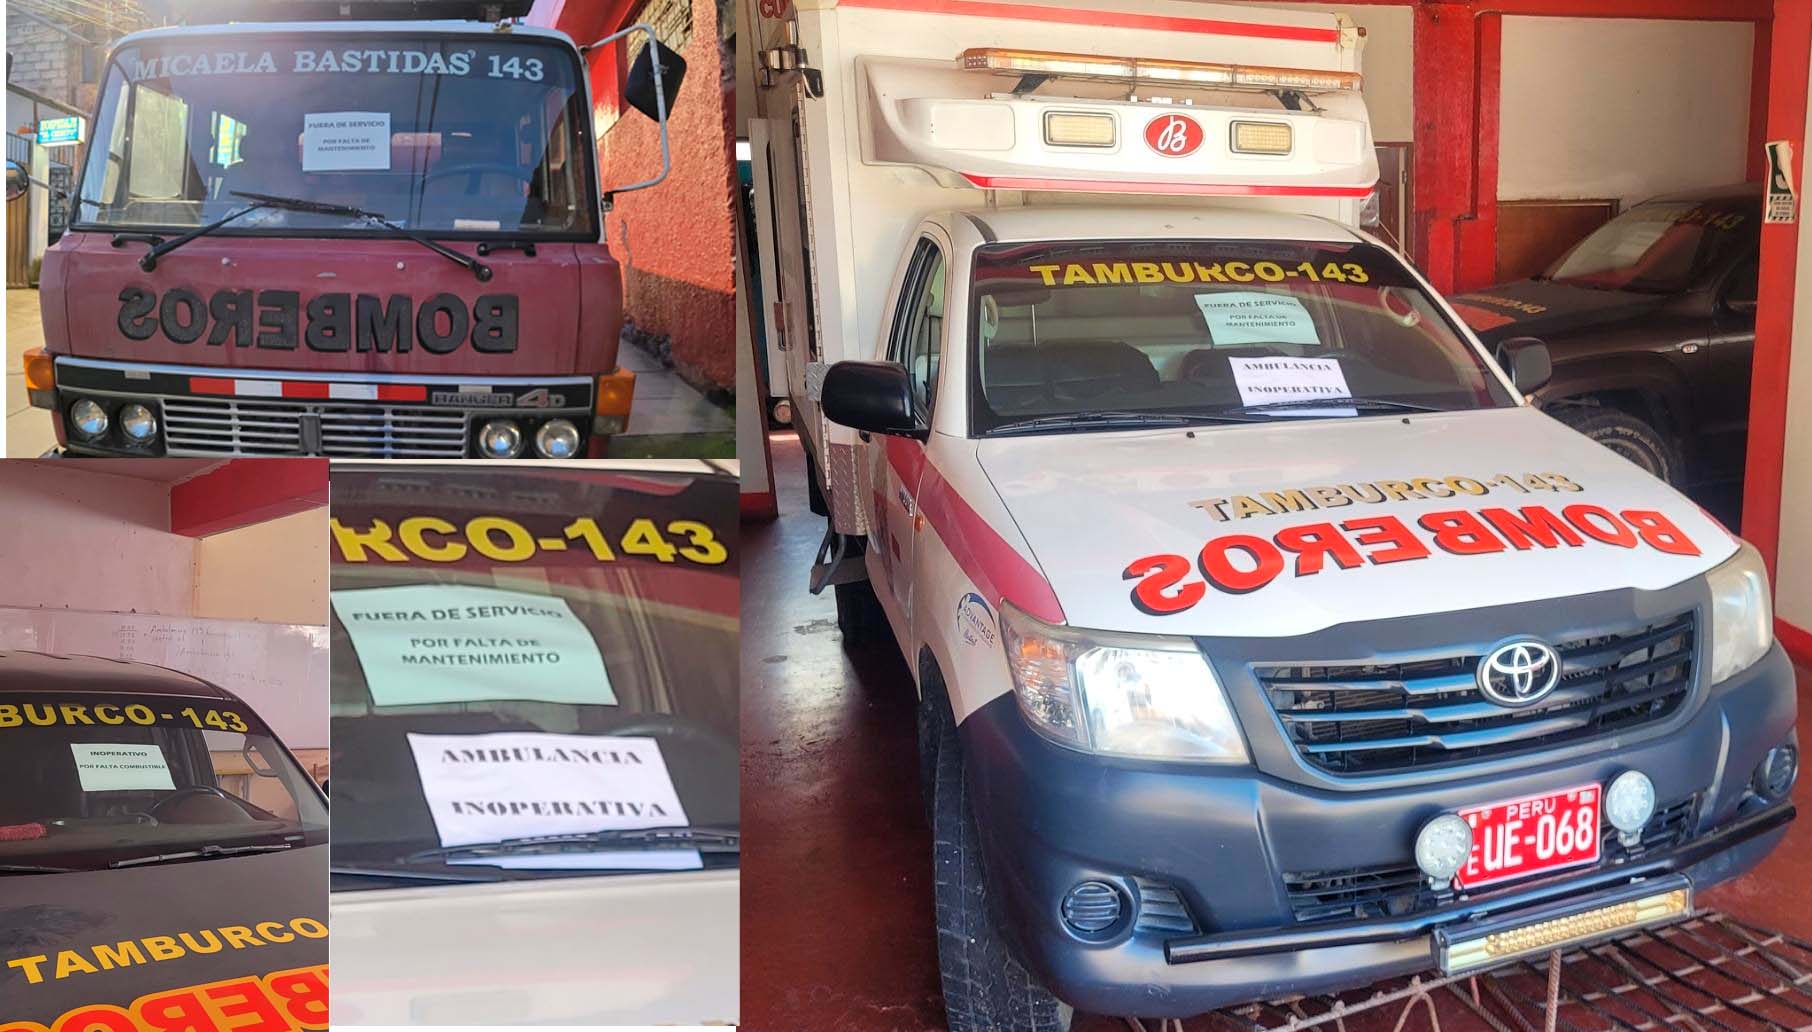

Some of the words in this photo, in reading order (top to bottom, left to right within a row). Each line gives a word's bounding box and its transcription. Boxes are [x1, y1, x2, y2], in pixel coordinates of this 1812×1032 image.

[488, 55, 544, 82] 143
[348, 120, 385, 128] SERVICIO
[1030, 262, 1369, 285] TAMBURCO-143
[1243, 362, 1332, 372] AMBULANCIA
[1247, 385, 1344, 394] INOPERATIVA
[1191, 472, 1585, 522] TAMBURCO-143
[352, 609, 427, 622] FUERA
[431, 607, 460, 621] DE
[465, 605, 564, 620] SERVICIO
[410, 637, 450, 649] POR
[453, 637, 512, 649] FALTA
[516, 638, 541, 648] DE
[401, 652, 561, 666] MANTENIMIENTO
[441, 747, 643, 765] AMBULANCIA
[451, 800, 669, 818] INOPERATIVA
[1506, 798, 1557, 822] PERU
[1483, 805, 1594, 873] UE-068
[6, 917, 329, 985] TAMBURCO
